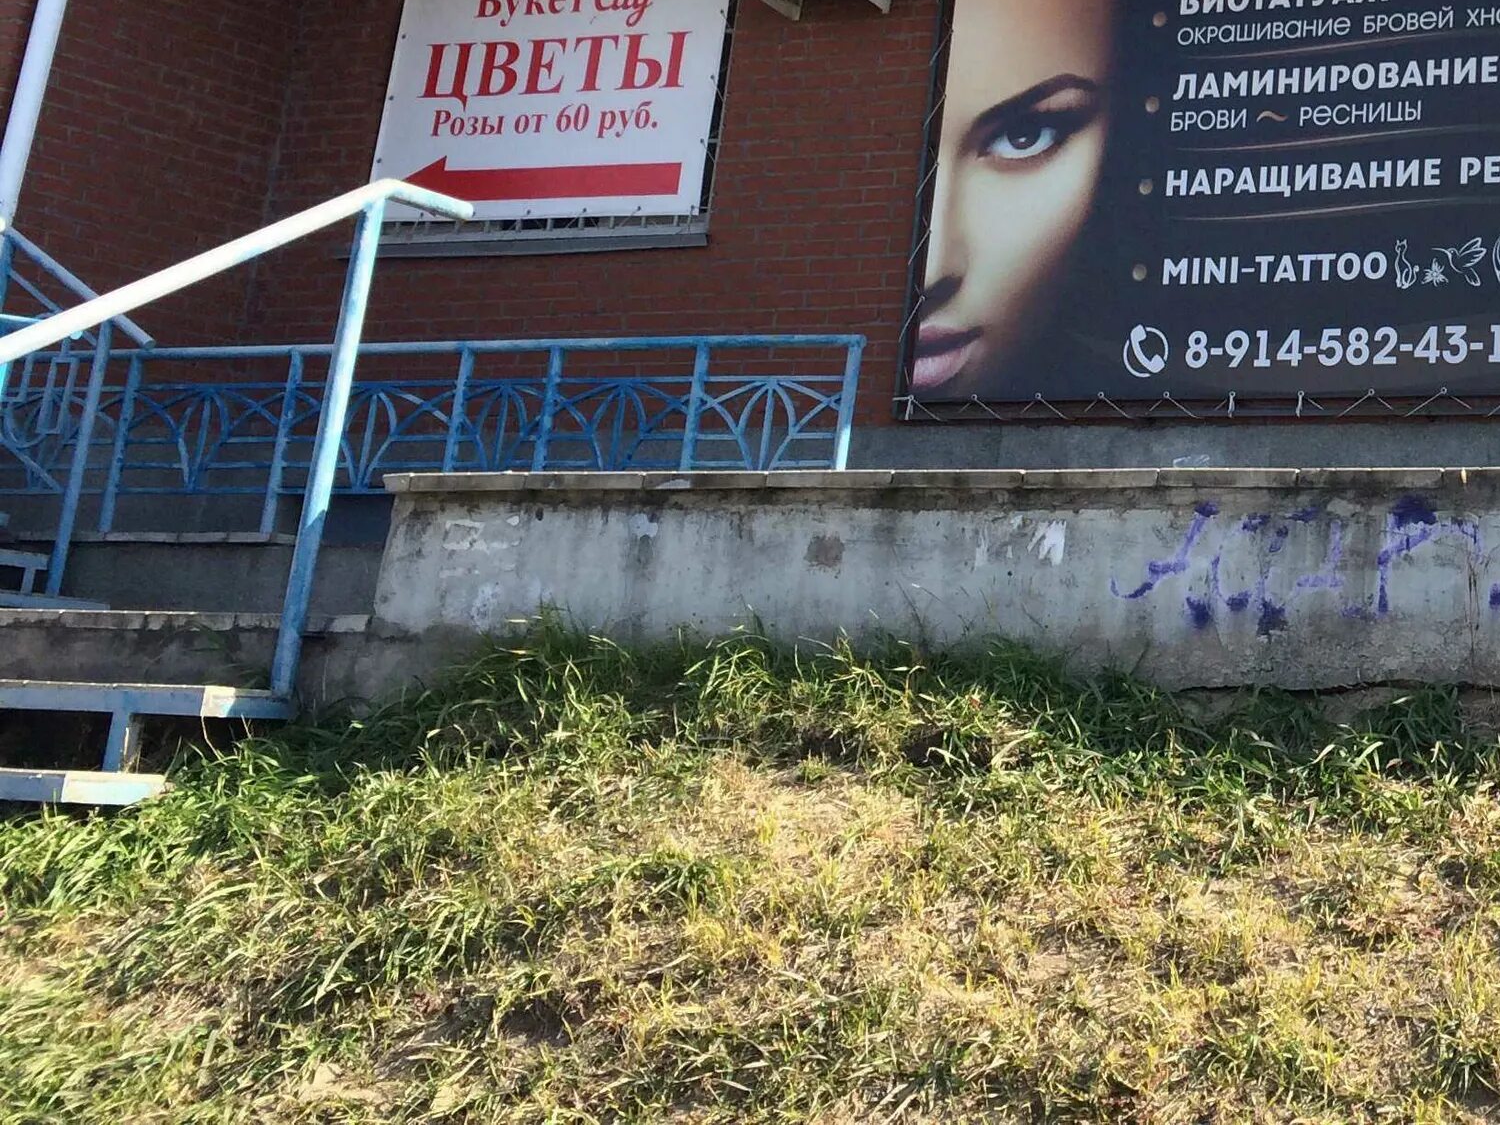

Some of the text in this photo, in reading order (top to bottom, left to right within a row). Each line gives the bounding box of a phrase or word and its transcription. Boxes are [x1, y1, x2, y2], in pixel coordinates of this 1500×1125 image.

[416, 30, 694, 111] ЦВЕТЫ
[1172, 55, 1500, 101] ЛАМИНИРОВАНИЕ
[429, 101, 658, 138] Розы от 60 руб.
[1169, 108, 1248, 132] БРОВИ
[1164, 158, 1442, 198] НАРАЩИВАНИЕ
[1161, 250, 1388, 285] MINI-TATTOO
